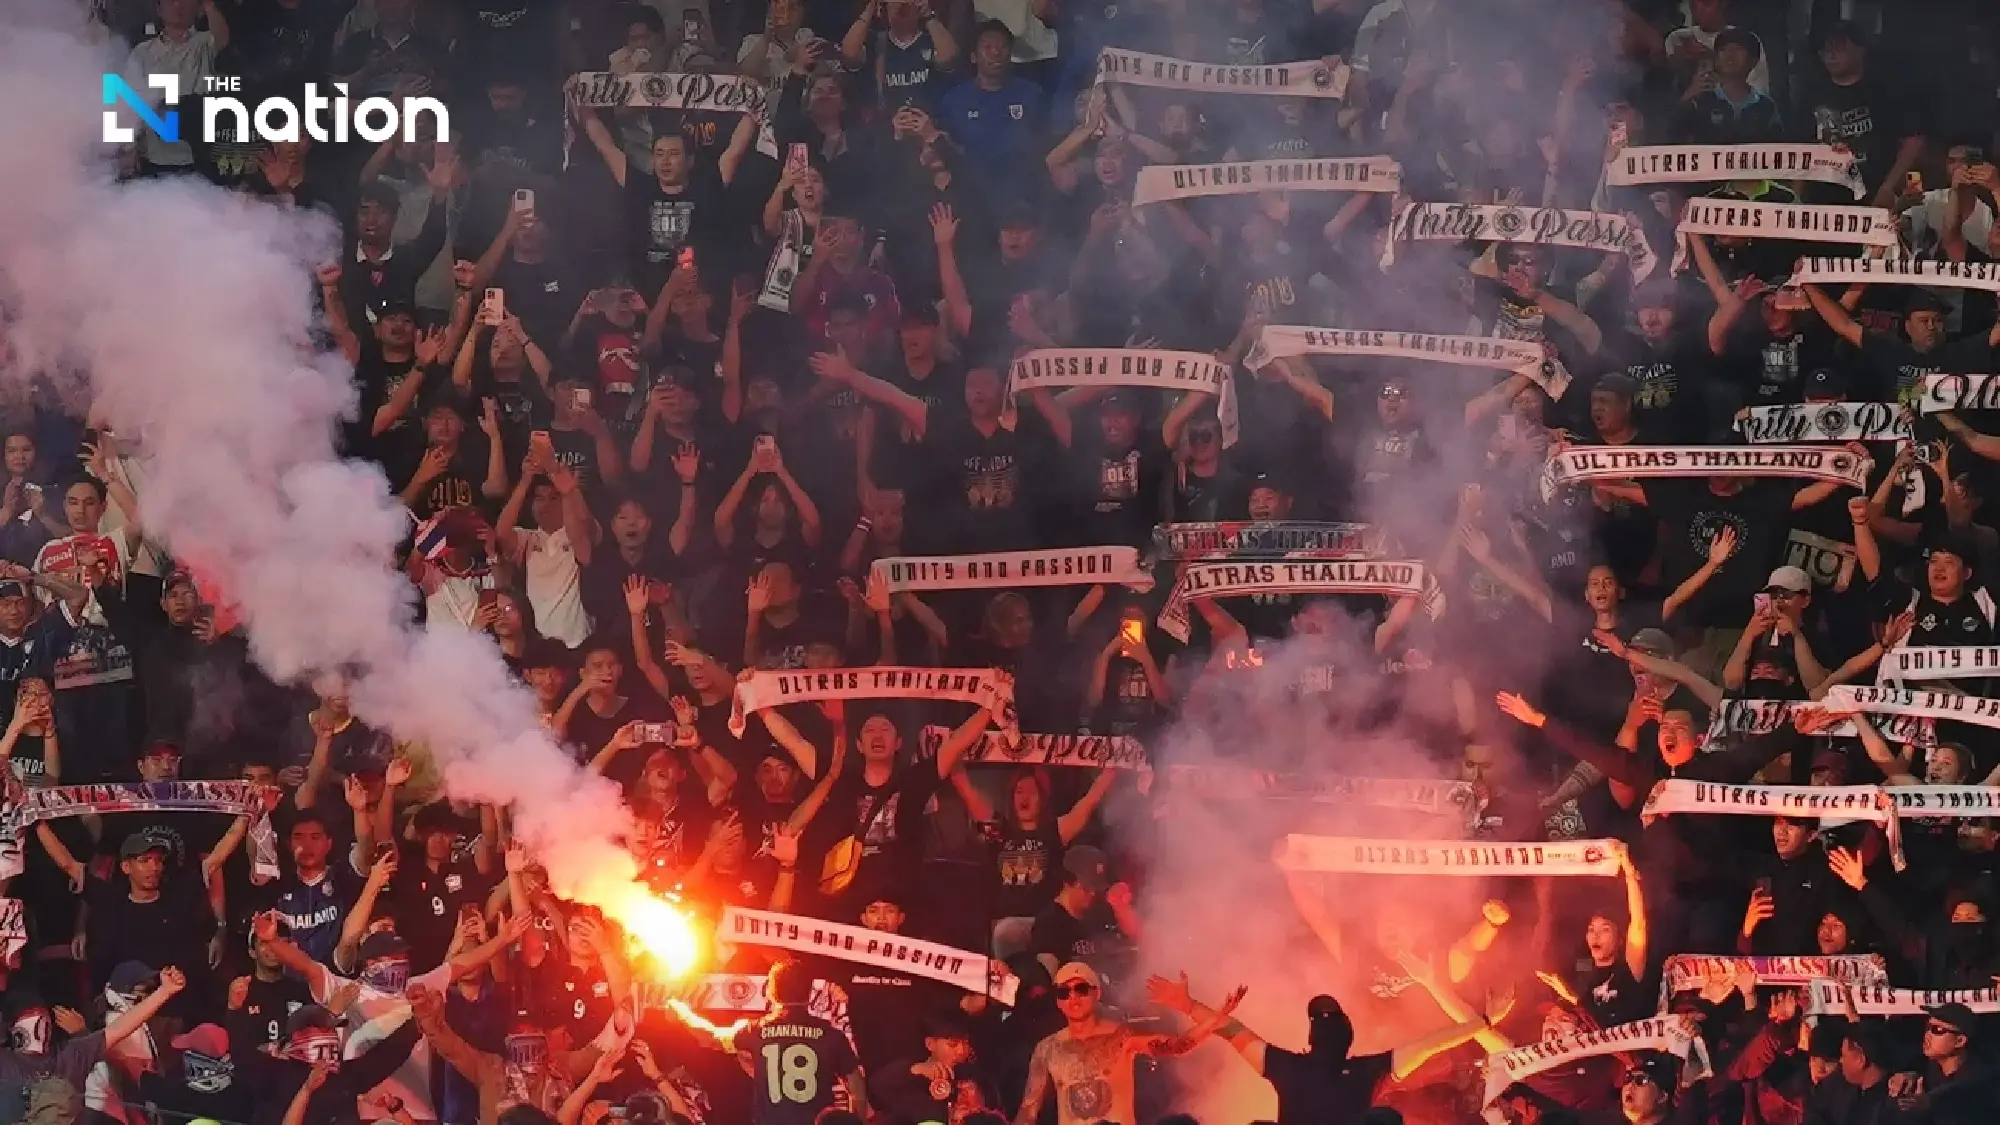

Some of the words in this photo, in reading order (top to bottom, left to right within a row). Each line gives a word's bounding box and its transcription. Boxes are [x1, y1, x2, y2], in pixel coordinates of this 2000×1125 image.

[1101, 53, 1142, 75] NITY
[1202, 66, 1289, 86] PASSION
[574, 73, 634, 108] nity
[1626, 152, 1699, 174] ULTRAS
[1711, 151, 1812, 170] THAILAND
[1173, 165, 1252, 189] ULTRAS
[1264, 162, 1369, 184] THAILAND
[1690, 205, 1763, 227] ULTRAS
[1774, 210, 1873, 234] THAILAND
[1810, 258, 1872, 273] UNITY
[1884, 259, 1924, 275] AND
[1936, 261, 2000, 281] PASSI
[1304, 331, 1384, 347] ULTRAS
[1398, 333, 1504, 361] THAILAND
[1016, 356, 1109, 380] PASSION
[1121, 356, 1163, 377] AND
[1174, 359, 1226, 384] NITY
[1741, 404, 1812, 441] nity
[1571, 451, 1678, 471] ULTRAS
[1685, 450, 1823, 469] THAILAND
[891, 562, 954, 582] UNITY
[967, 561, 1007, 580] AND
[1021, 554, 1112, 577] PASSION
[1282, 564, 1414, 585] THAILAND
[1899, 648, 1961, 670] UNITY
[777, 672, 858, 695] ULTRAS
[871, 670, 981, 695] THAILAND
[1854, 687, 1912, 705] UNITY
[1925, 693, 1964, 710] AND
[1974, 698, 2000, 717] PA
[1694, 783, 1769, 806] ULTRAS
[1935, 791, 2000, 807] THAIL
[1354, 846, 1430, 865] ULTRAS
[1441, 846, 1544, 866] THAILAND
[431, 896, 445, 916] 9
[734, 913, 799, 940] UNITY
[813, 929, 854, 951] AND
[867, 939, 964, 975] PASSION
[1822, 984, 1896, 1004] ULRAS
[1910, 988, 1999, 1006] THAILAN
[573, 998, 586, 1020] 9
[267, 1019, 279, 1040] 9
[761, 1023, 824, 1040] CHANATHIP
[1503, 1039, 1570, 1071] ULTRAS
[1573, 1019, 1666, 1049] THAILAND
[761, 1042, 820, 1104] 18
